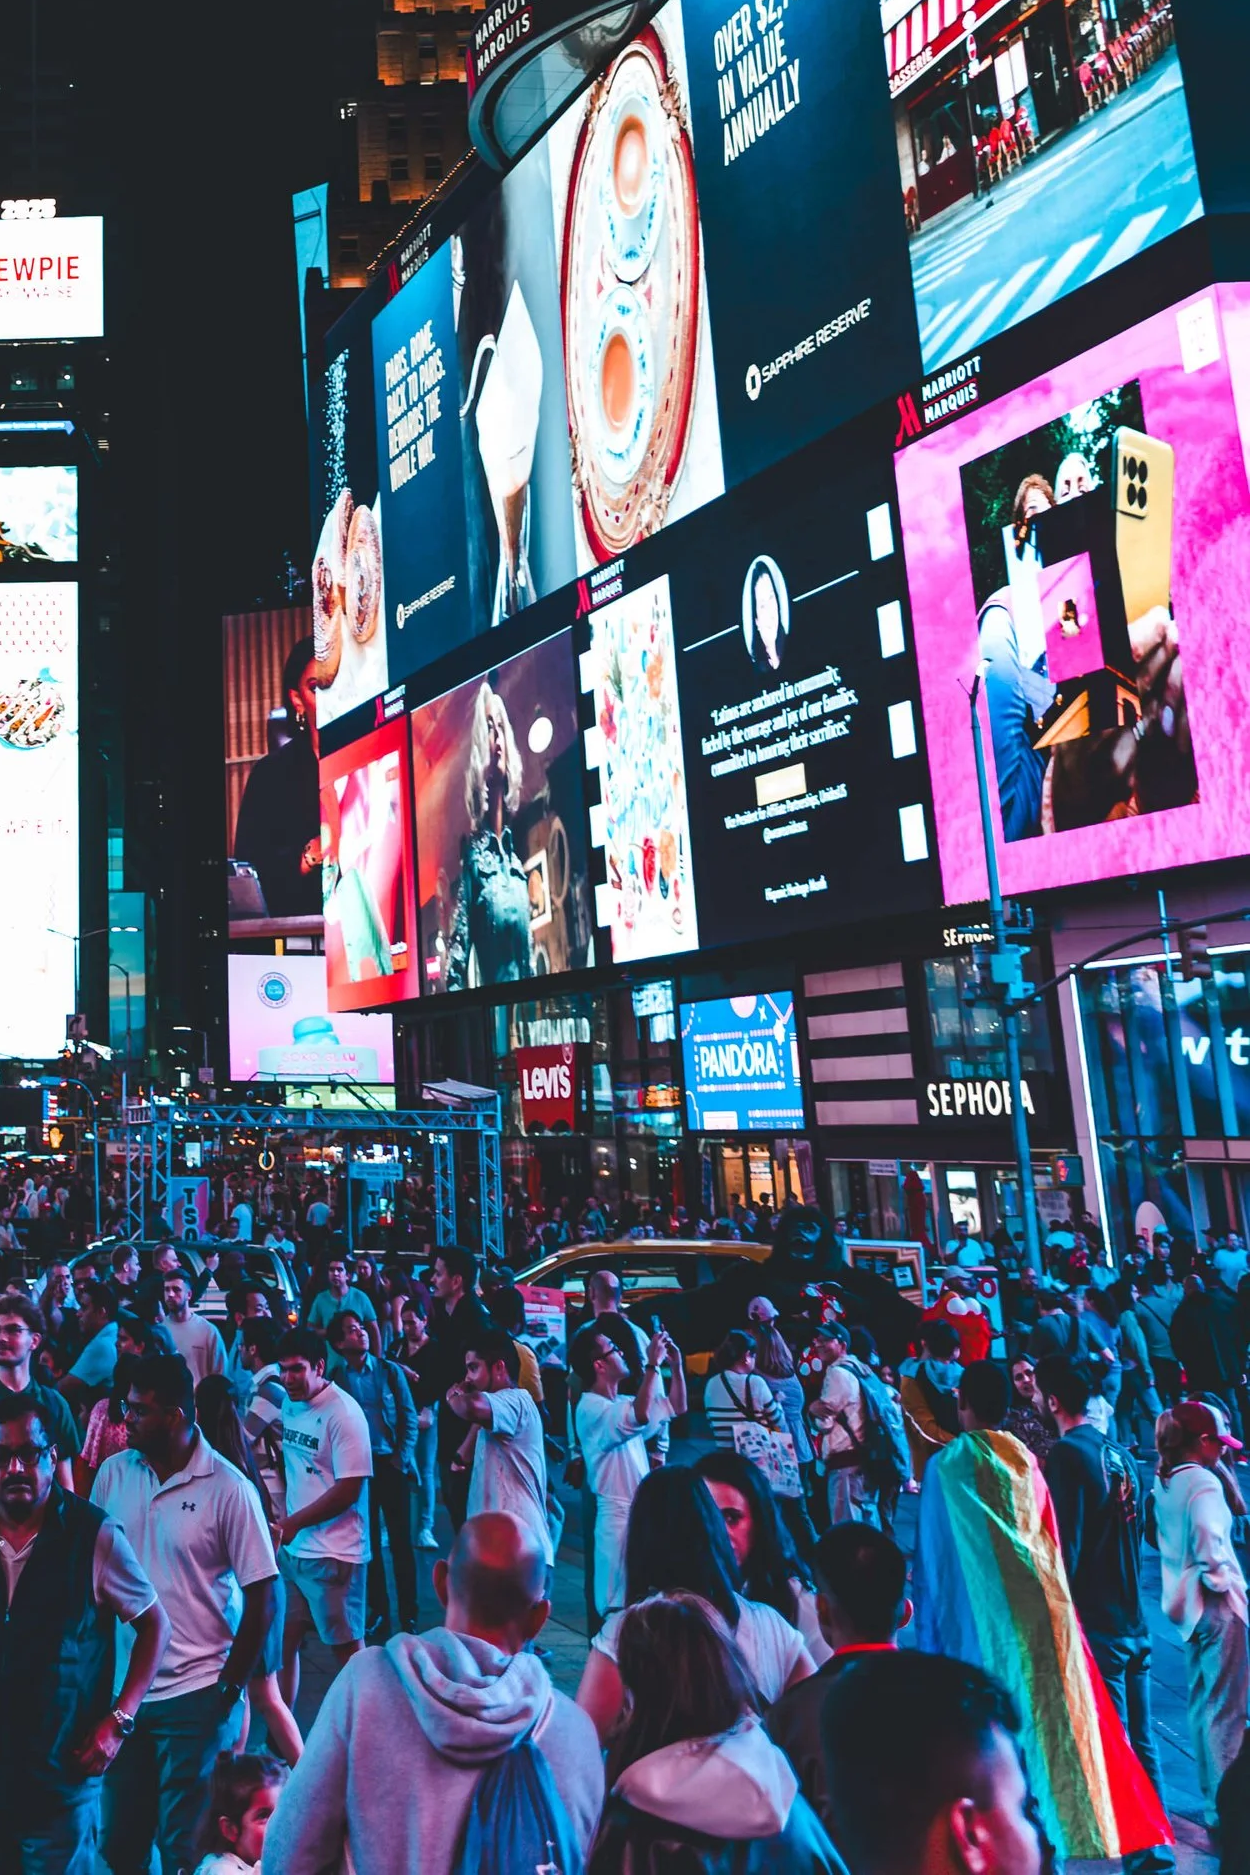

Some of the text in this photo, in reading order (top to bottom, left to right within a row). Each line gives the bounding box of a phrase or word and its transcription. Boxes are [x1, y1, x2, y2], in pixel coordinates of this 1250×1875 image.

[477, 13, 530, 76] MARQUIS
[714, 4, 754, 71] OVER
[718, 21, 787, 119] IN VALUE
[724, 58, 800, 166] ANNUALLY
[385, 319, 436, 392] PARIS. ROME.
[761, 301, 870, 383] SAPPHIRE RESERVE
[387, 348, 446, 426] BACK TO PARIS.
[922, 355, 981, 402] MARRIOTT
[924, 382, 978, 426] MARQUIS
[388, 386, 442, 460] REWARDS THE
[389, 444, 418, 493] WHOLE
[591, 558, 625, 588] MARRIOTT
[700, 1041, 779, 1079] PANDORA
[927, 1080, 1036, 1117] SEPHORA
